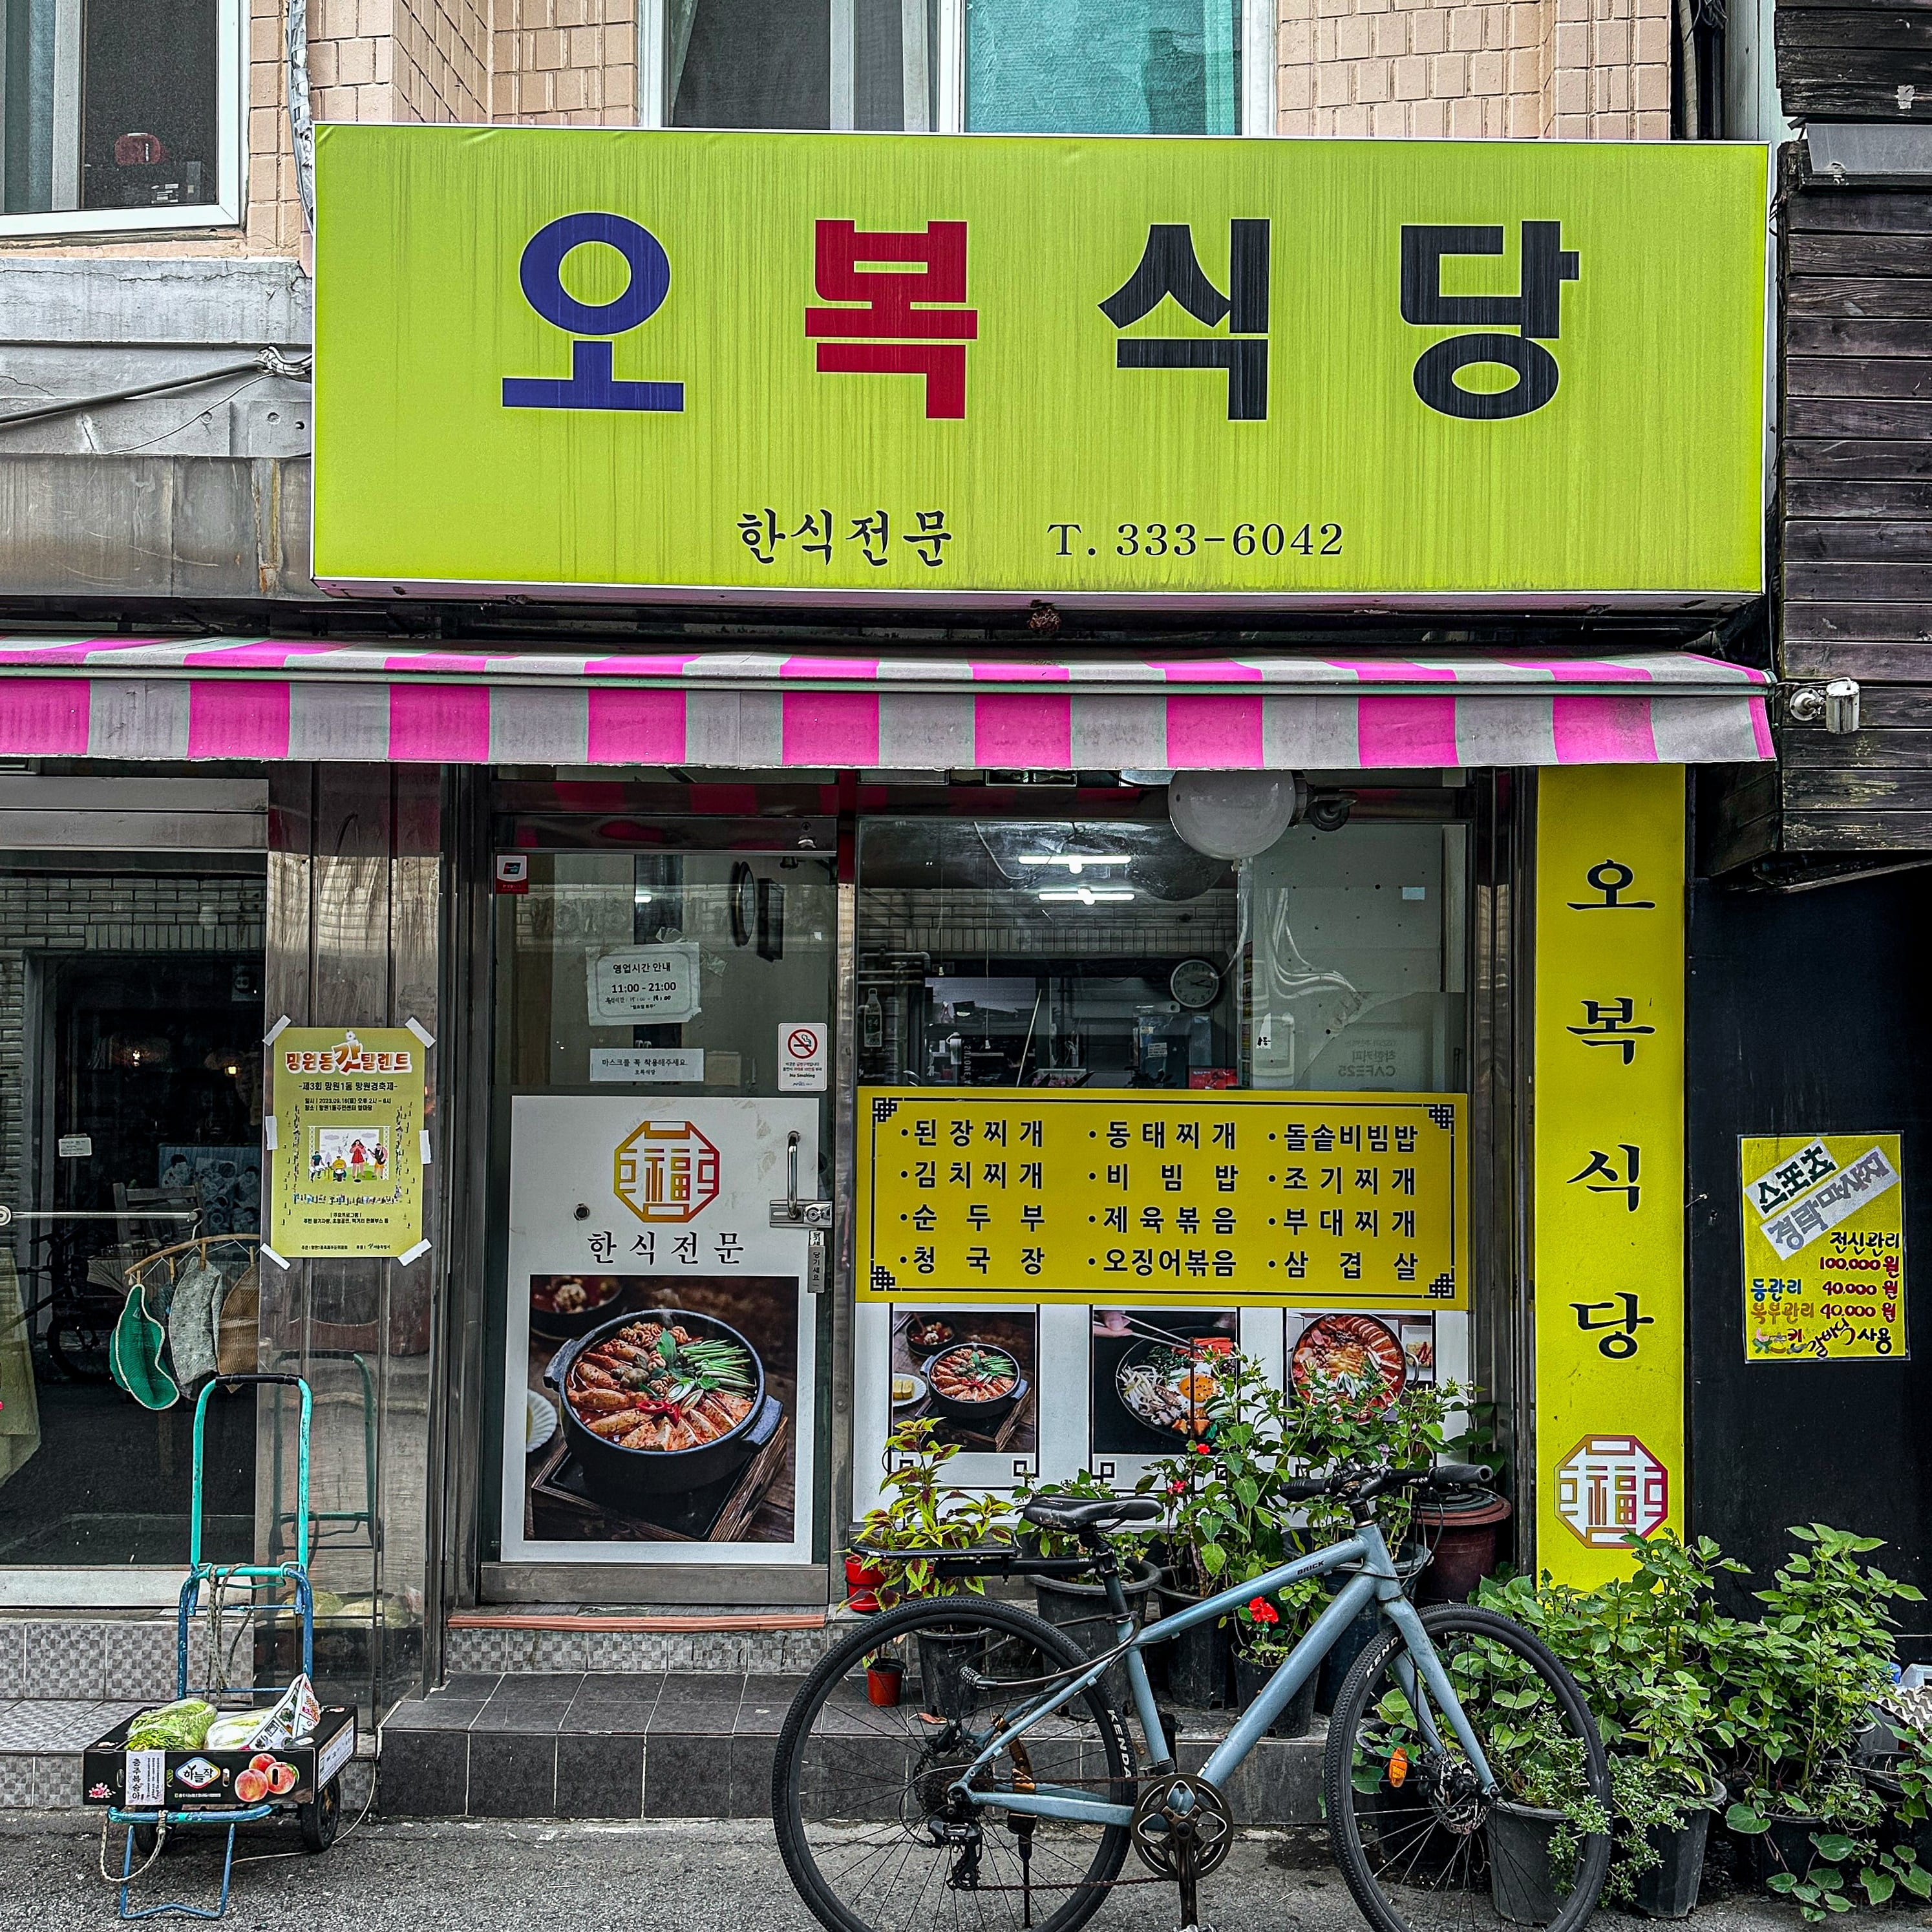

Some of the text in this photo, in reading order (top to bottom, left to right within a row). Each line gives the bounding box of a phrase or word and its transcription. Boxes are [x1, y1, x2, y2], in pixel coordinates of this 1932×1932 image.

[502, 211, 1580, 420] 오복식당
[737, 508, 951, 567] 한식전문
[1047, 523, 1343, 556] T. 333-6042
[613, 962, 671, 974] 영업시간 안내
[611, 983, 639, 993] 11:00
[648, 982, 677, 992] 21:00
[602, 1058, 630, 1067] 마스크를
[325, 1081, 353, 1090] 망원1동
[1566, 859, 1655, 1359] 오복식당
[915, 1120, 1042, 1147] 된장찌개
[1107, 1121, 1235, 1149] 동태찌개
[1284, 1124, 1417, 1152] 돌솥비빔밥
[914, 1162, 1042, 1189] 김치찌개
[1107, 1164, 1238, 1191] 비빔밥
[1284, 1167, 1414, 1195] 조기찌개
[1758, 1145, 1837, 1214] 스포츠
[913, 1204, 1045, 1231] 순두부
[1104, 1206, 1236, 1234] 제육볶음
[1284, 1209, 1414, 1237] 부대찌개
[587, 1231, 744, 1266] 한식전문
[1829, 1231, 1900, 1257] 전신관리
[812, 1251, 821, 1281] 당기세요
[914, 1247, 1045, 1274] 청국장
[1104, 1249, 1236, 1277] 오징어볶음
[1284, 1251, 1417, 1280] 삼겹살
[1750, 1279, 1801, 1302] 등관리
[1750, 1302, 1814, 1324] 복부관리
[1857, 1327, 1893, 1355] 사용
[1297, 1560, 1324, 1575] BRICK
[1366, 1634, 1403, 1679] KEND
[1107, 1710, 1132, 1778] KENDA
[183, 1765, 214, 1783] 하늘작
